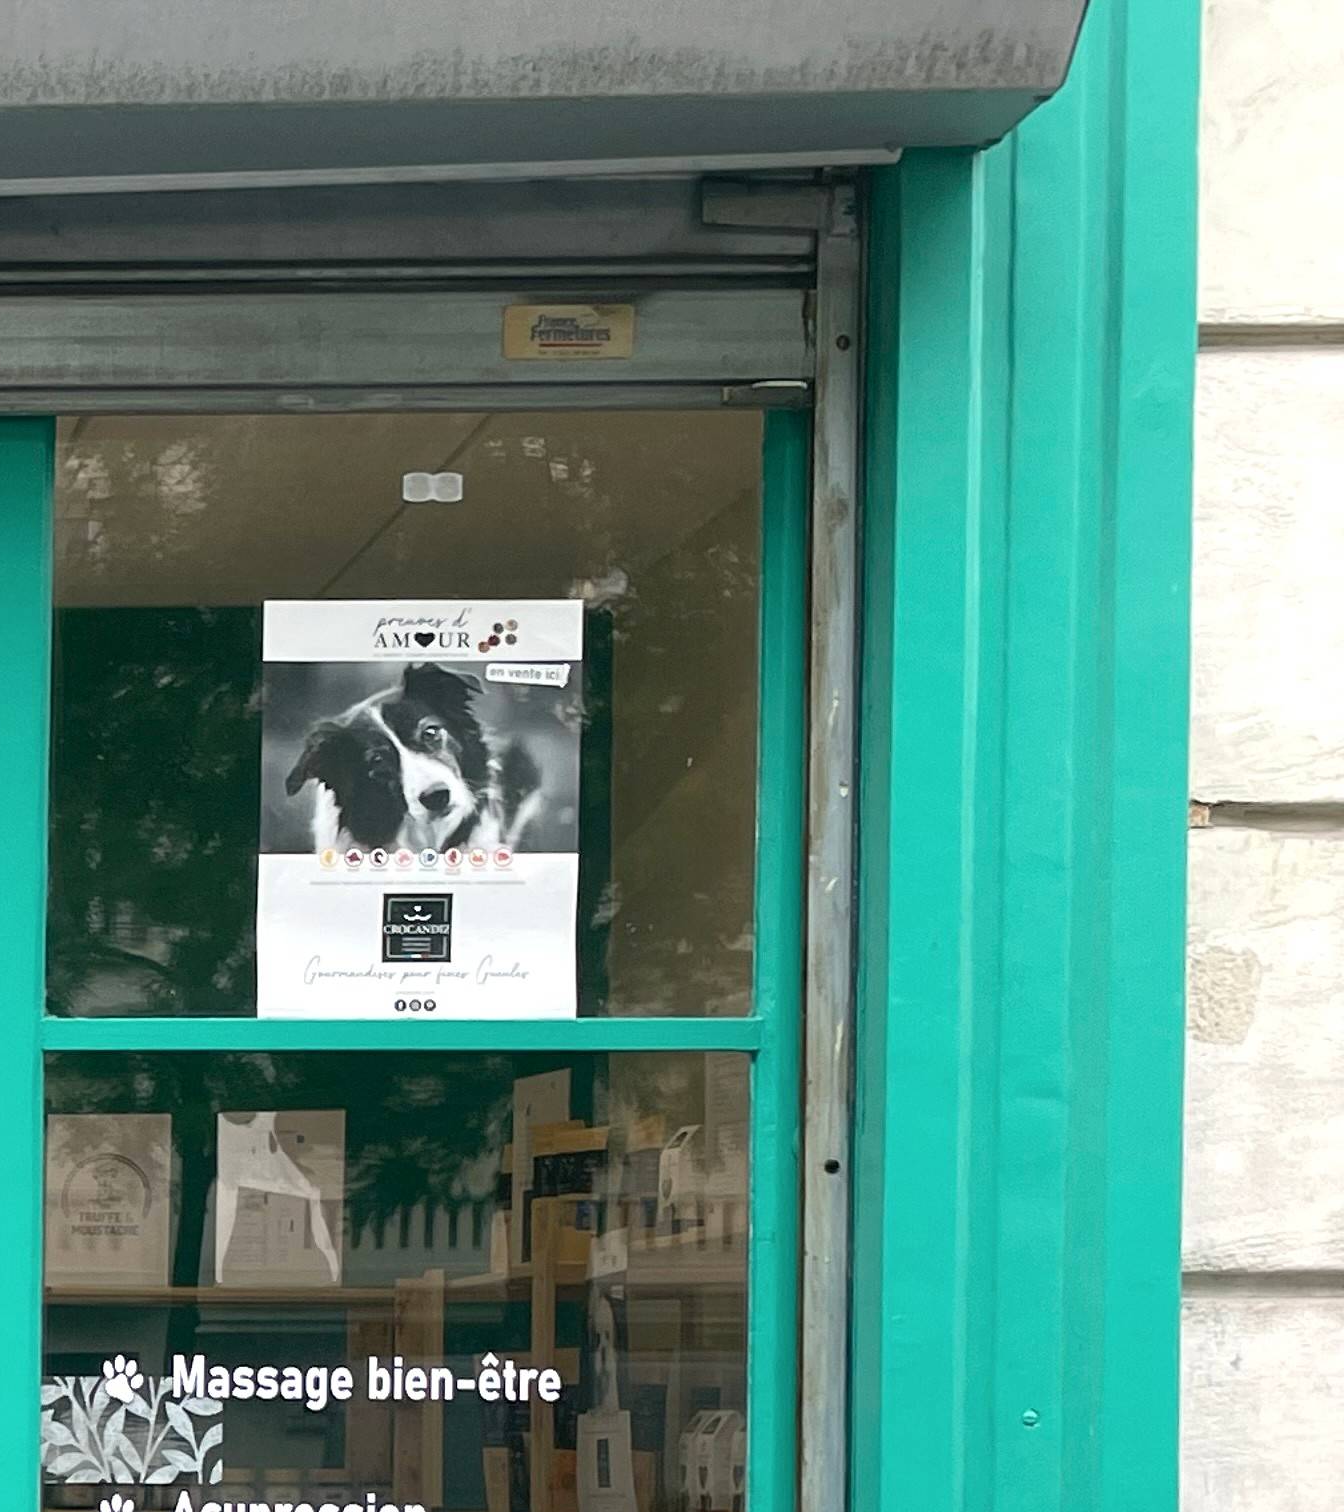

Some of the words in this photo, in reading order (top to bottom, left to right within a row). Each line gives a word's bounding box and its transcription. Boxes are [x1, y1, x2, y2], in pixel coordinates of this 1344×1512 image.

[489, 667, 504, 677] en
[508, 667, 541, 680] vente
[545, 669, 560, 680] ici
[383, 923, 451, 935] CROCANDIZ
[172, 1354, 353, 1411] Massage
[368, 1352, 562, 1402] bien-être
